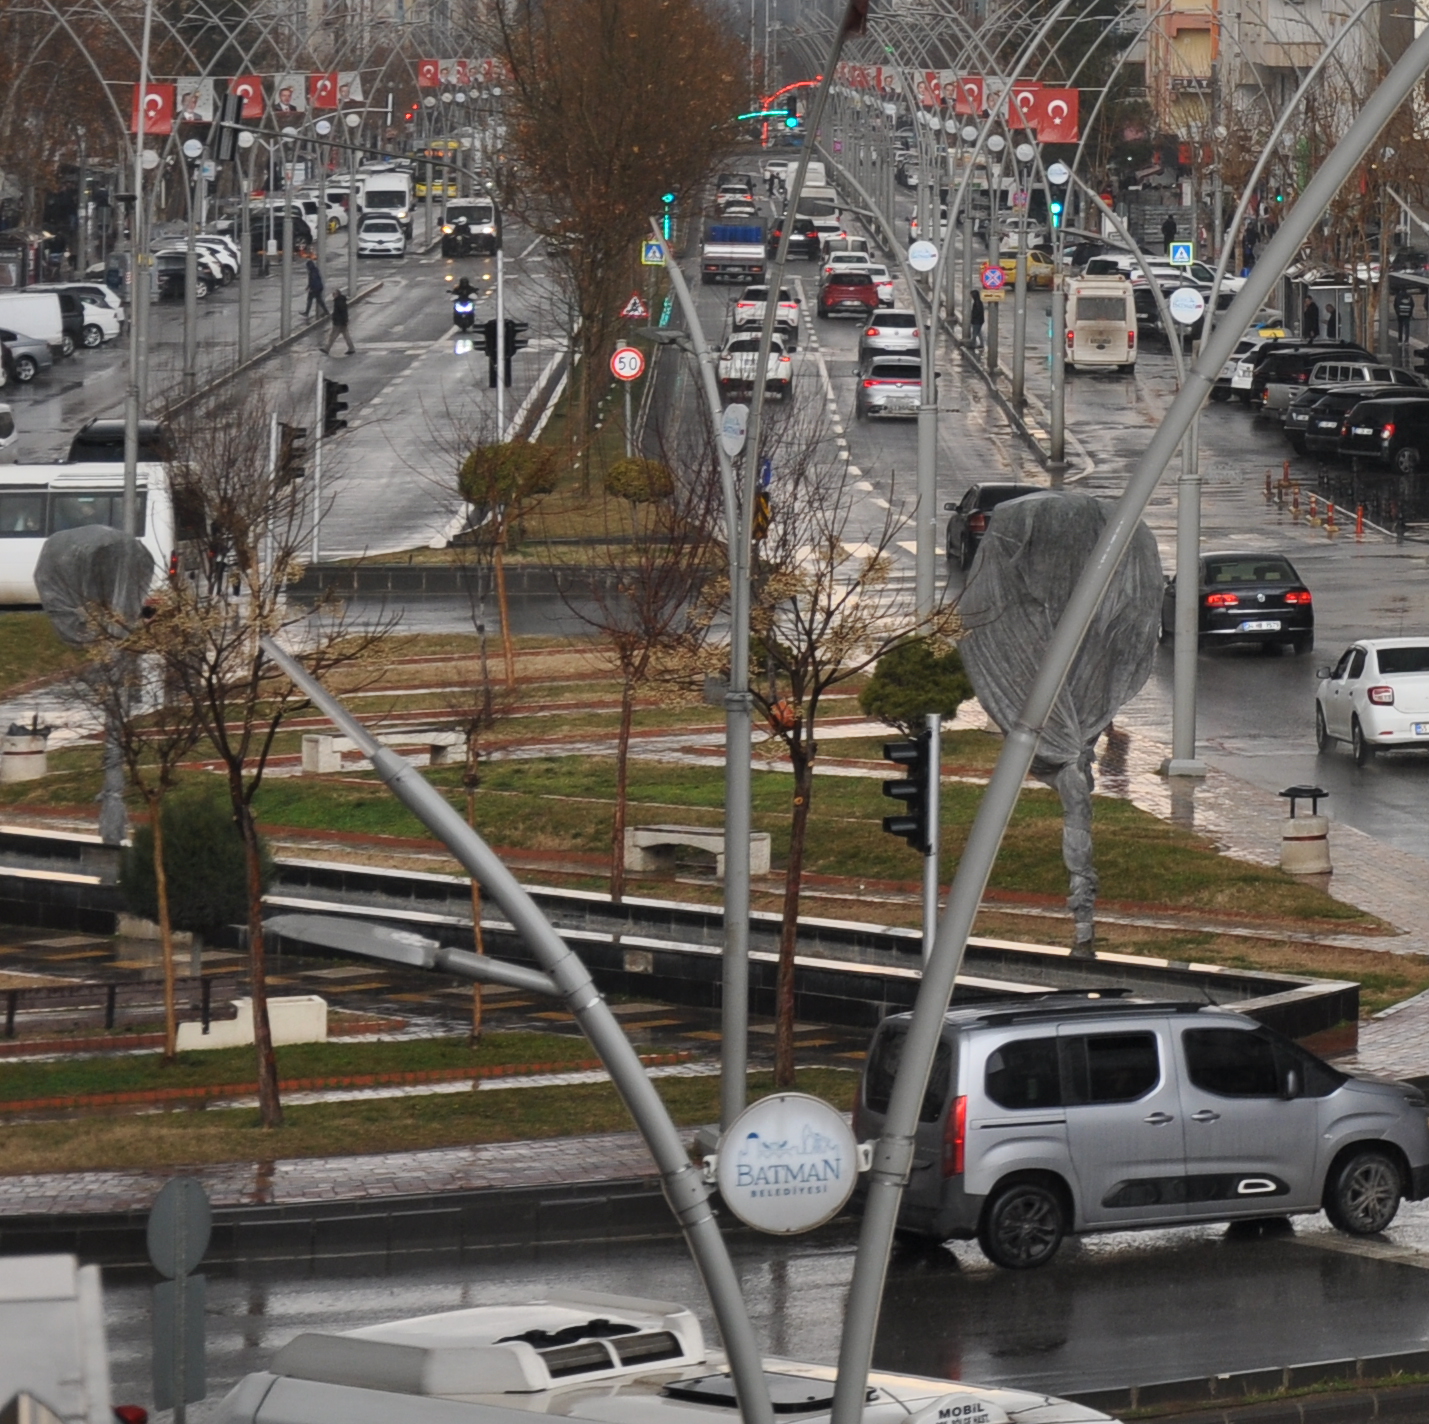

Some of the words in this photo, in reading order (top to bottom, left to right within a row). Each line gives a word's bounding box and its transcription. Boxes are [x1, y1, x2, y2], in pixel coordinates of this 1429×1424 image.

[619, 357, 637, 371] 50
[736, 1158, 842, 1187] BATMAN
[751, 1185, 828, 1198] BELEDİYESİ
